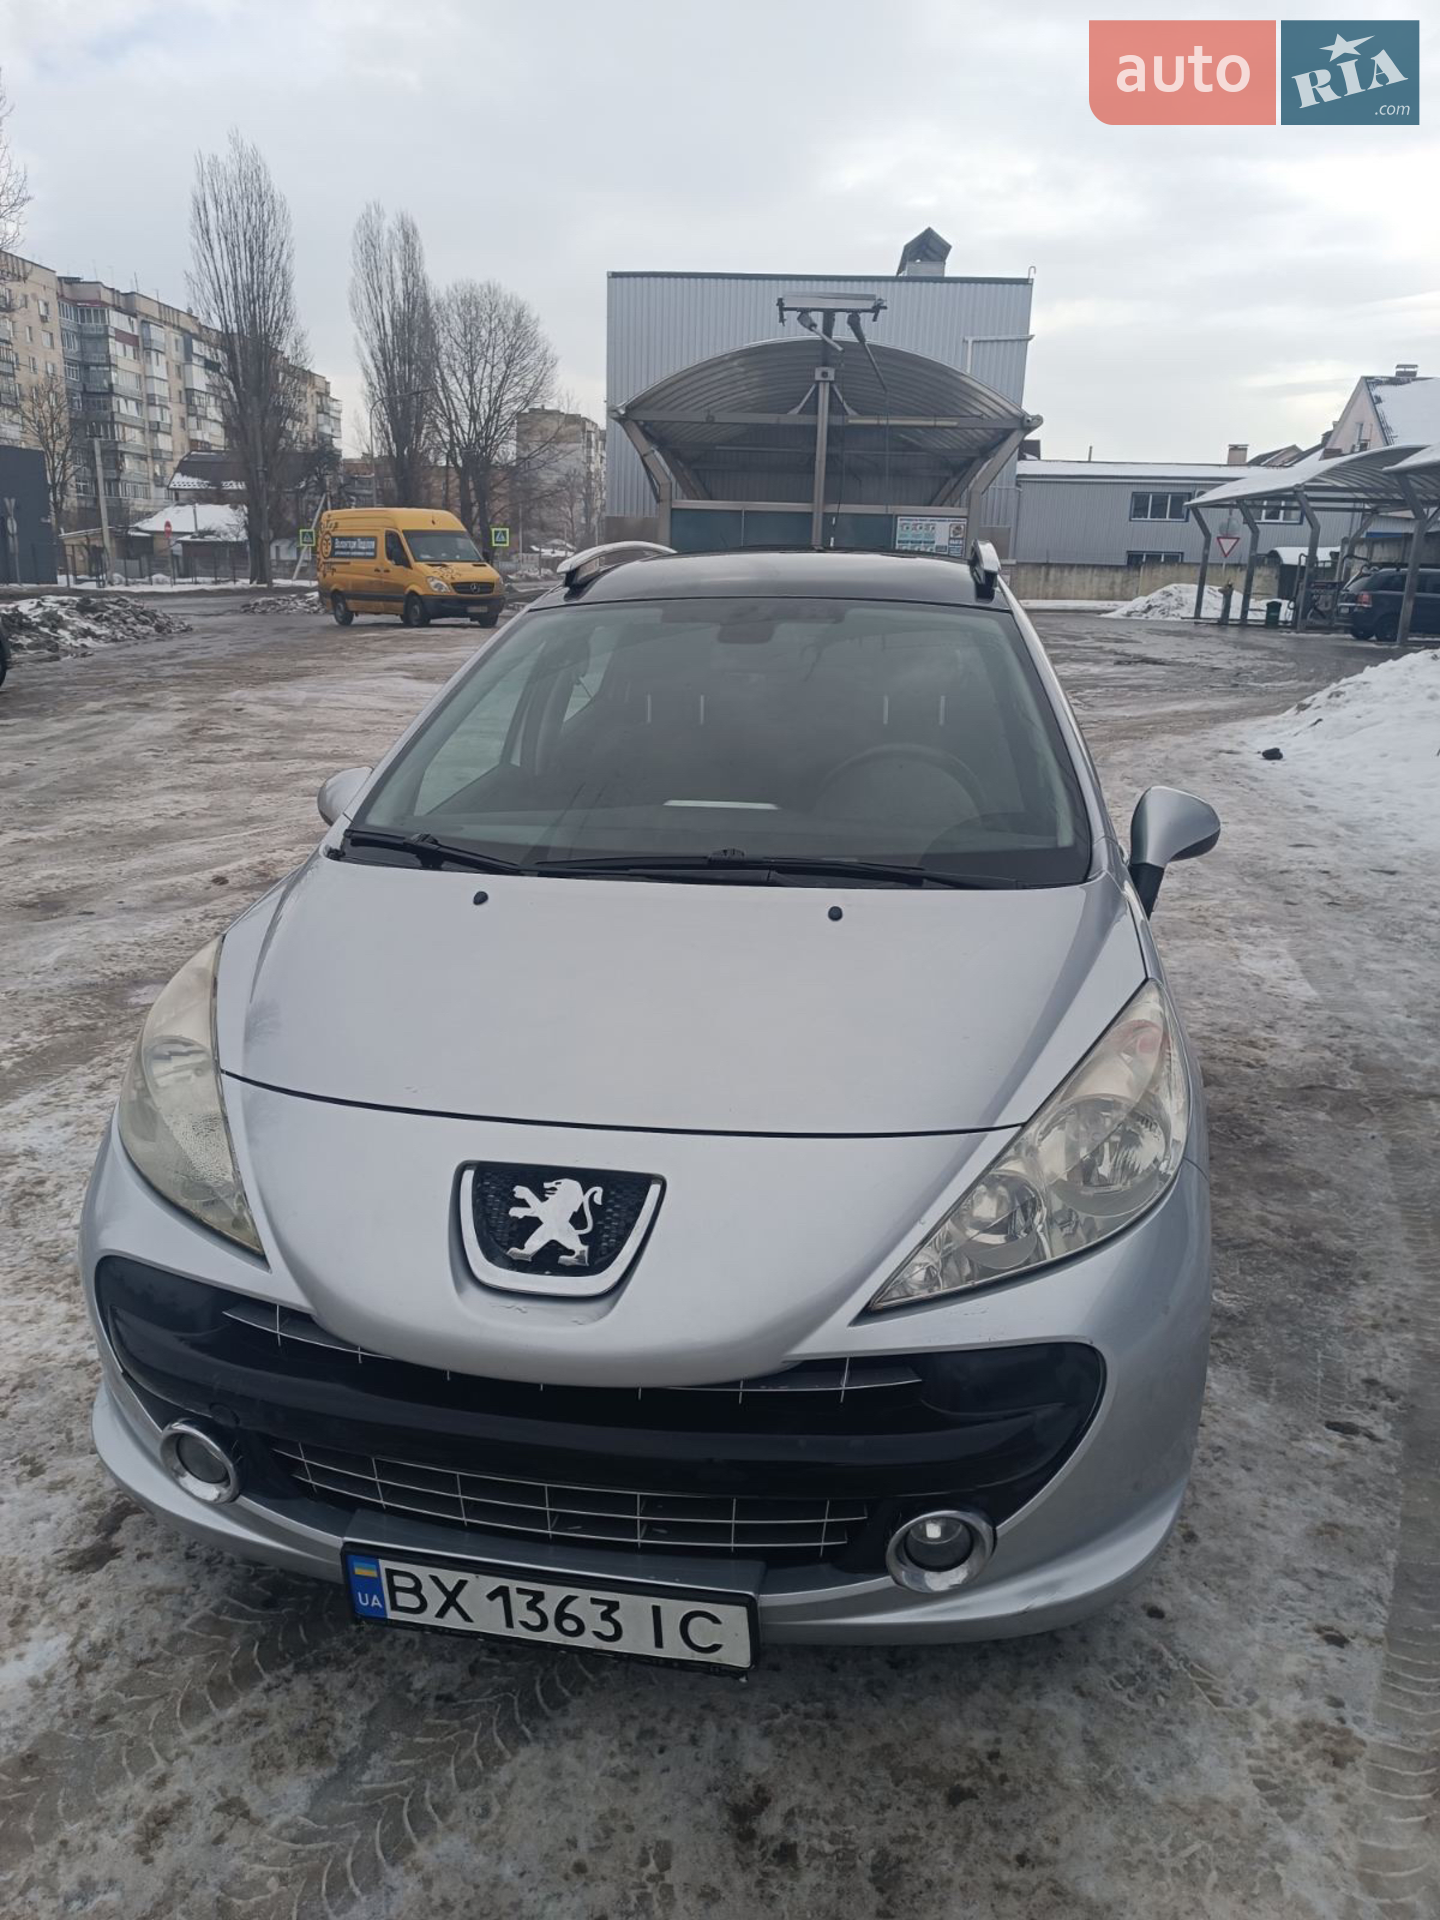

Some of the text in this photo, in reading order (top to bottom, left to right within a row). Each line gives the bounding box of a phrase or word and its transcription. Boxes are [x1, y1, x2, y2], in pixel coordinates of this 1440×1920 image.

[357, 1591, 383, 1609] UA
[385, 1567, 724, 1654] BX 1363 IC
